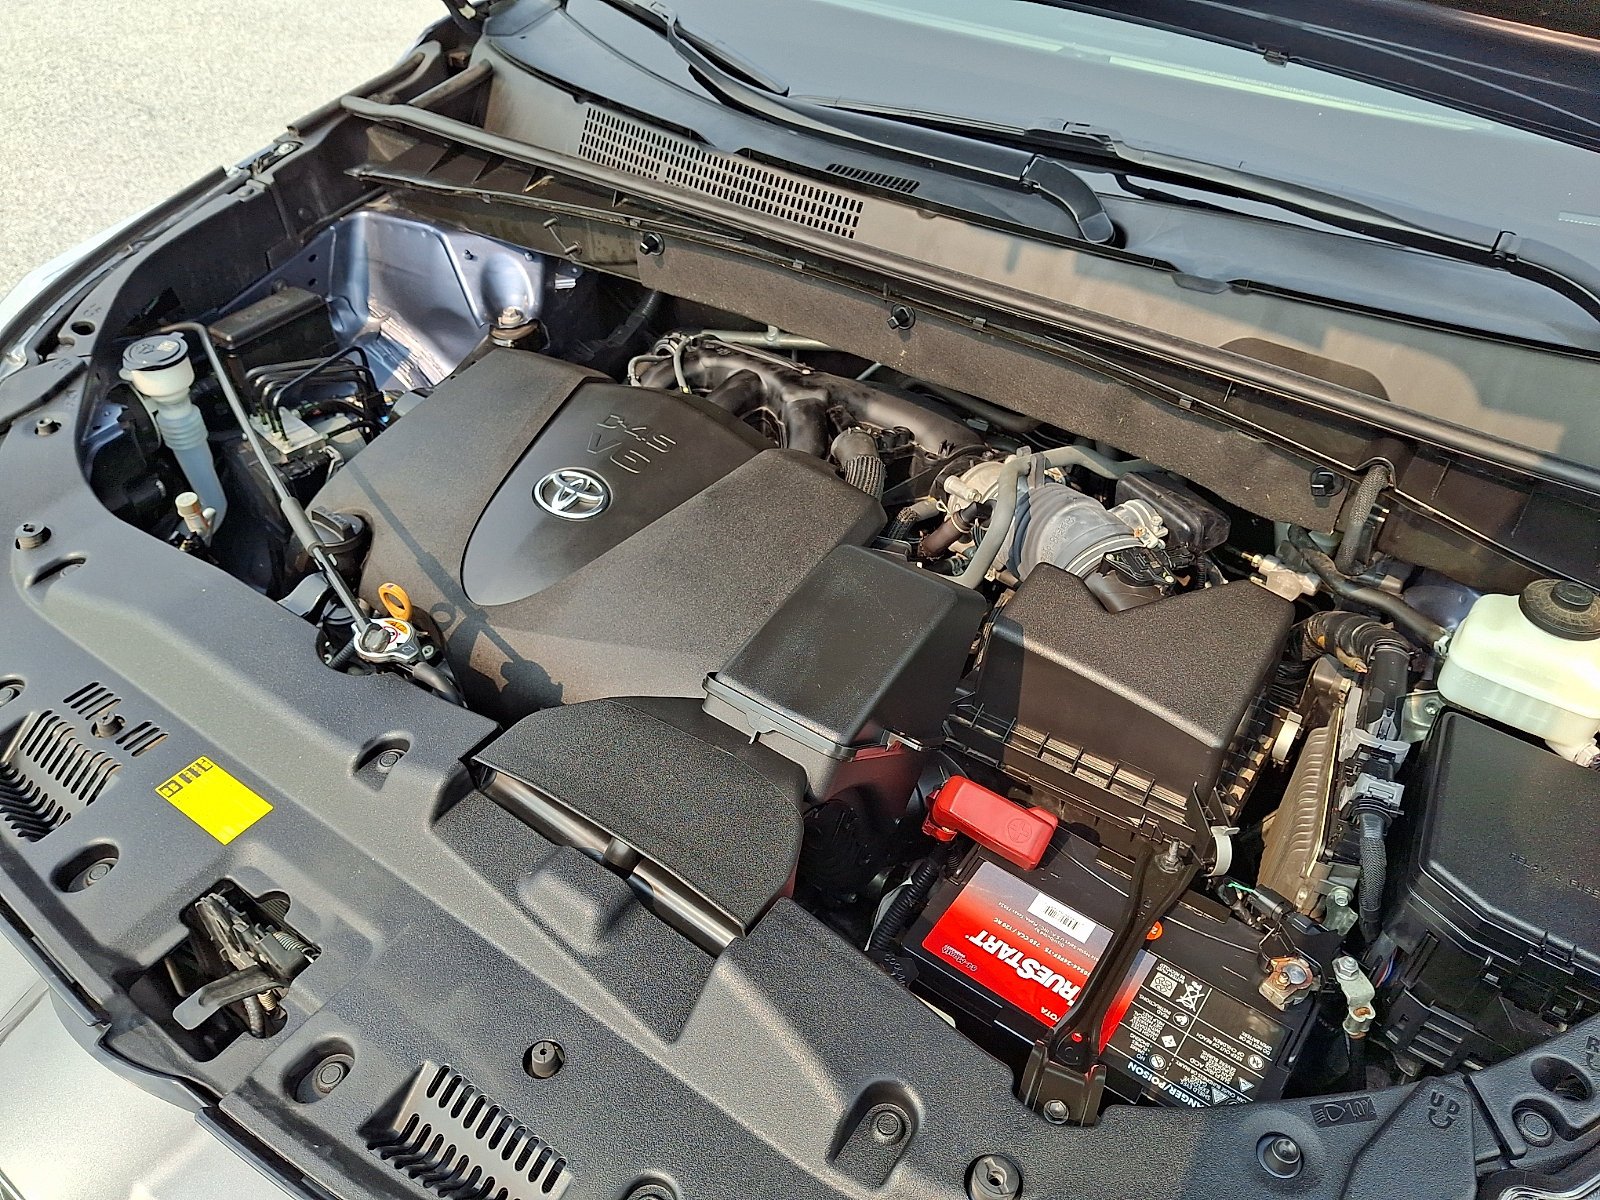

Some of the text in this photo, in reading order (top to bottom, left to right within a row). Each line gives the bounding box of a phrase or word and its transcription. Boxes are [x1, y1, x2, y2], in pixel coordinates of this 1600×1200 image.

[587, 433, 651, 474] V6
[1001, 922, 1012, 930] 120
[1016, 930, 1029, 940] CCA
[970, 931, 1079, 1005] RUESTART
[1156, 1009, 1169, 1019] READ
[1129, 1032, 1150, 1047] SMOKING
[1196, 1032, 1213, 1044] REACH
[1136, 1053, 1145, 1061] NO
[1199, 1053, 1208, 1061] OR
[1219, 1046, 1230, 1054] OUT
[1230, 1053, 1243, 1062] KEEP
[1189, 1057, 1230, 1084] SULFURIC ACID
[1205, 1061, 1232, 1081] CAN CAUSE
[1218, 1059, 1236, 1073] SEVERE
[1128, 1062, 1203, 1107] ANGER/POISON
[1183, 1075, 1209, 1094] EXPLOSIVE
[1197, 1073, 1221, 1089] BLINDNESS
[1192, 1086, 1210, 1100] SHIELD
[1220, 1086, 1235, 1098] CAUSE
[1430, 1089, 1445, 1106] U
